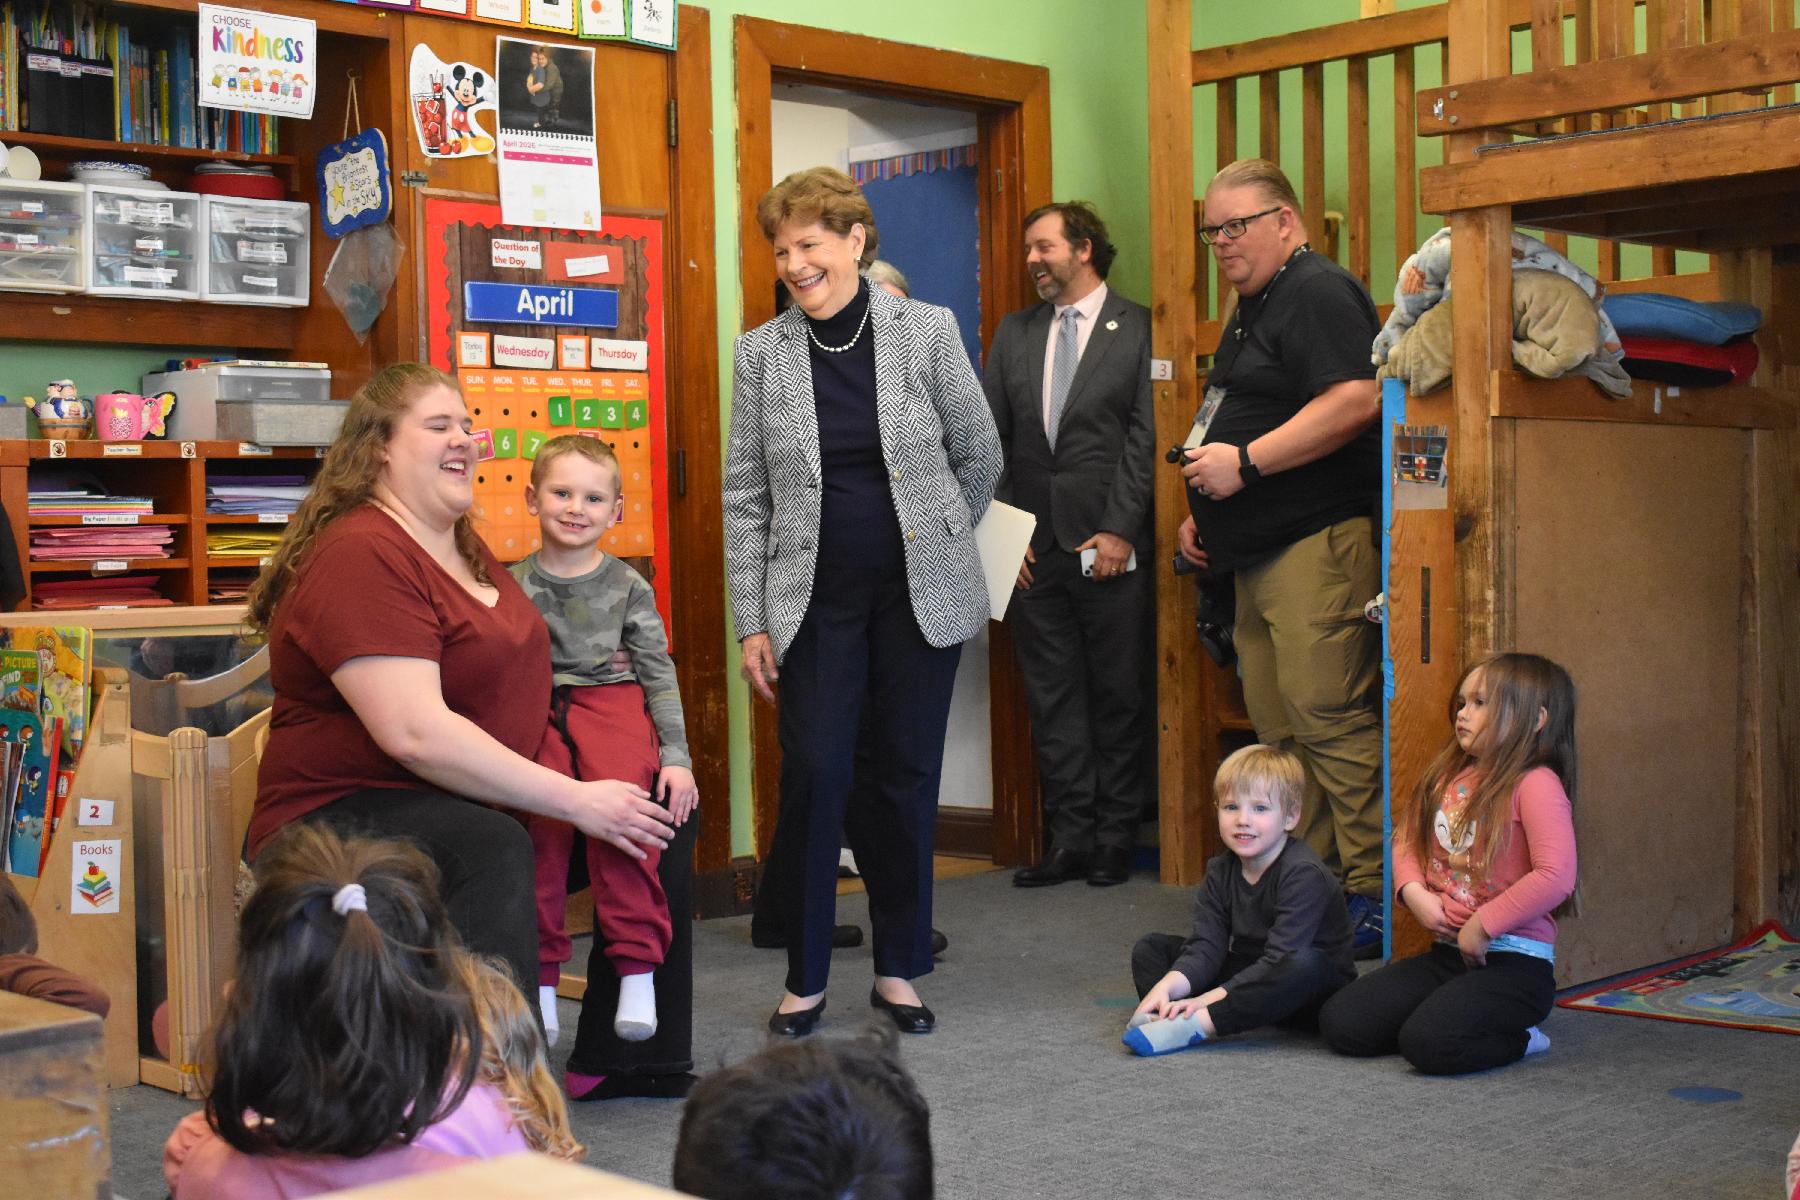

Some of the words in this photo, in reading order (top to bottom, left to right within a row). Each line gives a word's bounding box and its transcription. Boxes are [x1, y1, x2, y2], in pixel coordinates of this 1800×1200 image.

[212, 15, 252, 28] CHOOSE
[212, 25, 304, 63] Kindness
[493, 241, 529, 252] Question
[531, 243, 540, 252] of
[494, 255, 508, 265] the
[509, 256, 526, 267] Day
[517, 288, 574, 321] April
[496, 343, 550, 360] Wednesday
[598, 347, 638, 361] Thursday
[1159, 363, 1167, 377] 3
[557, 403, 563, 418] 1
[582, 406, 592, 420] 2
[607, 407, 617, 421] 3
[632, 407, 641, 421] 4
[502, 436, 511, 450] 6
[531, 438, 540, 453] 7
[4, 655, 37, 669] PICTURE
[1, 670, 21, 685] FIND
[89, 805, 101, 819] 2
[80, 843, 113, 856] Books
